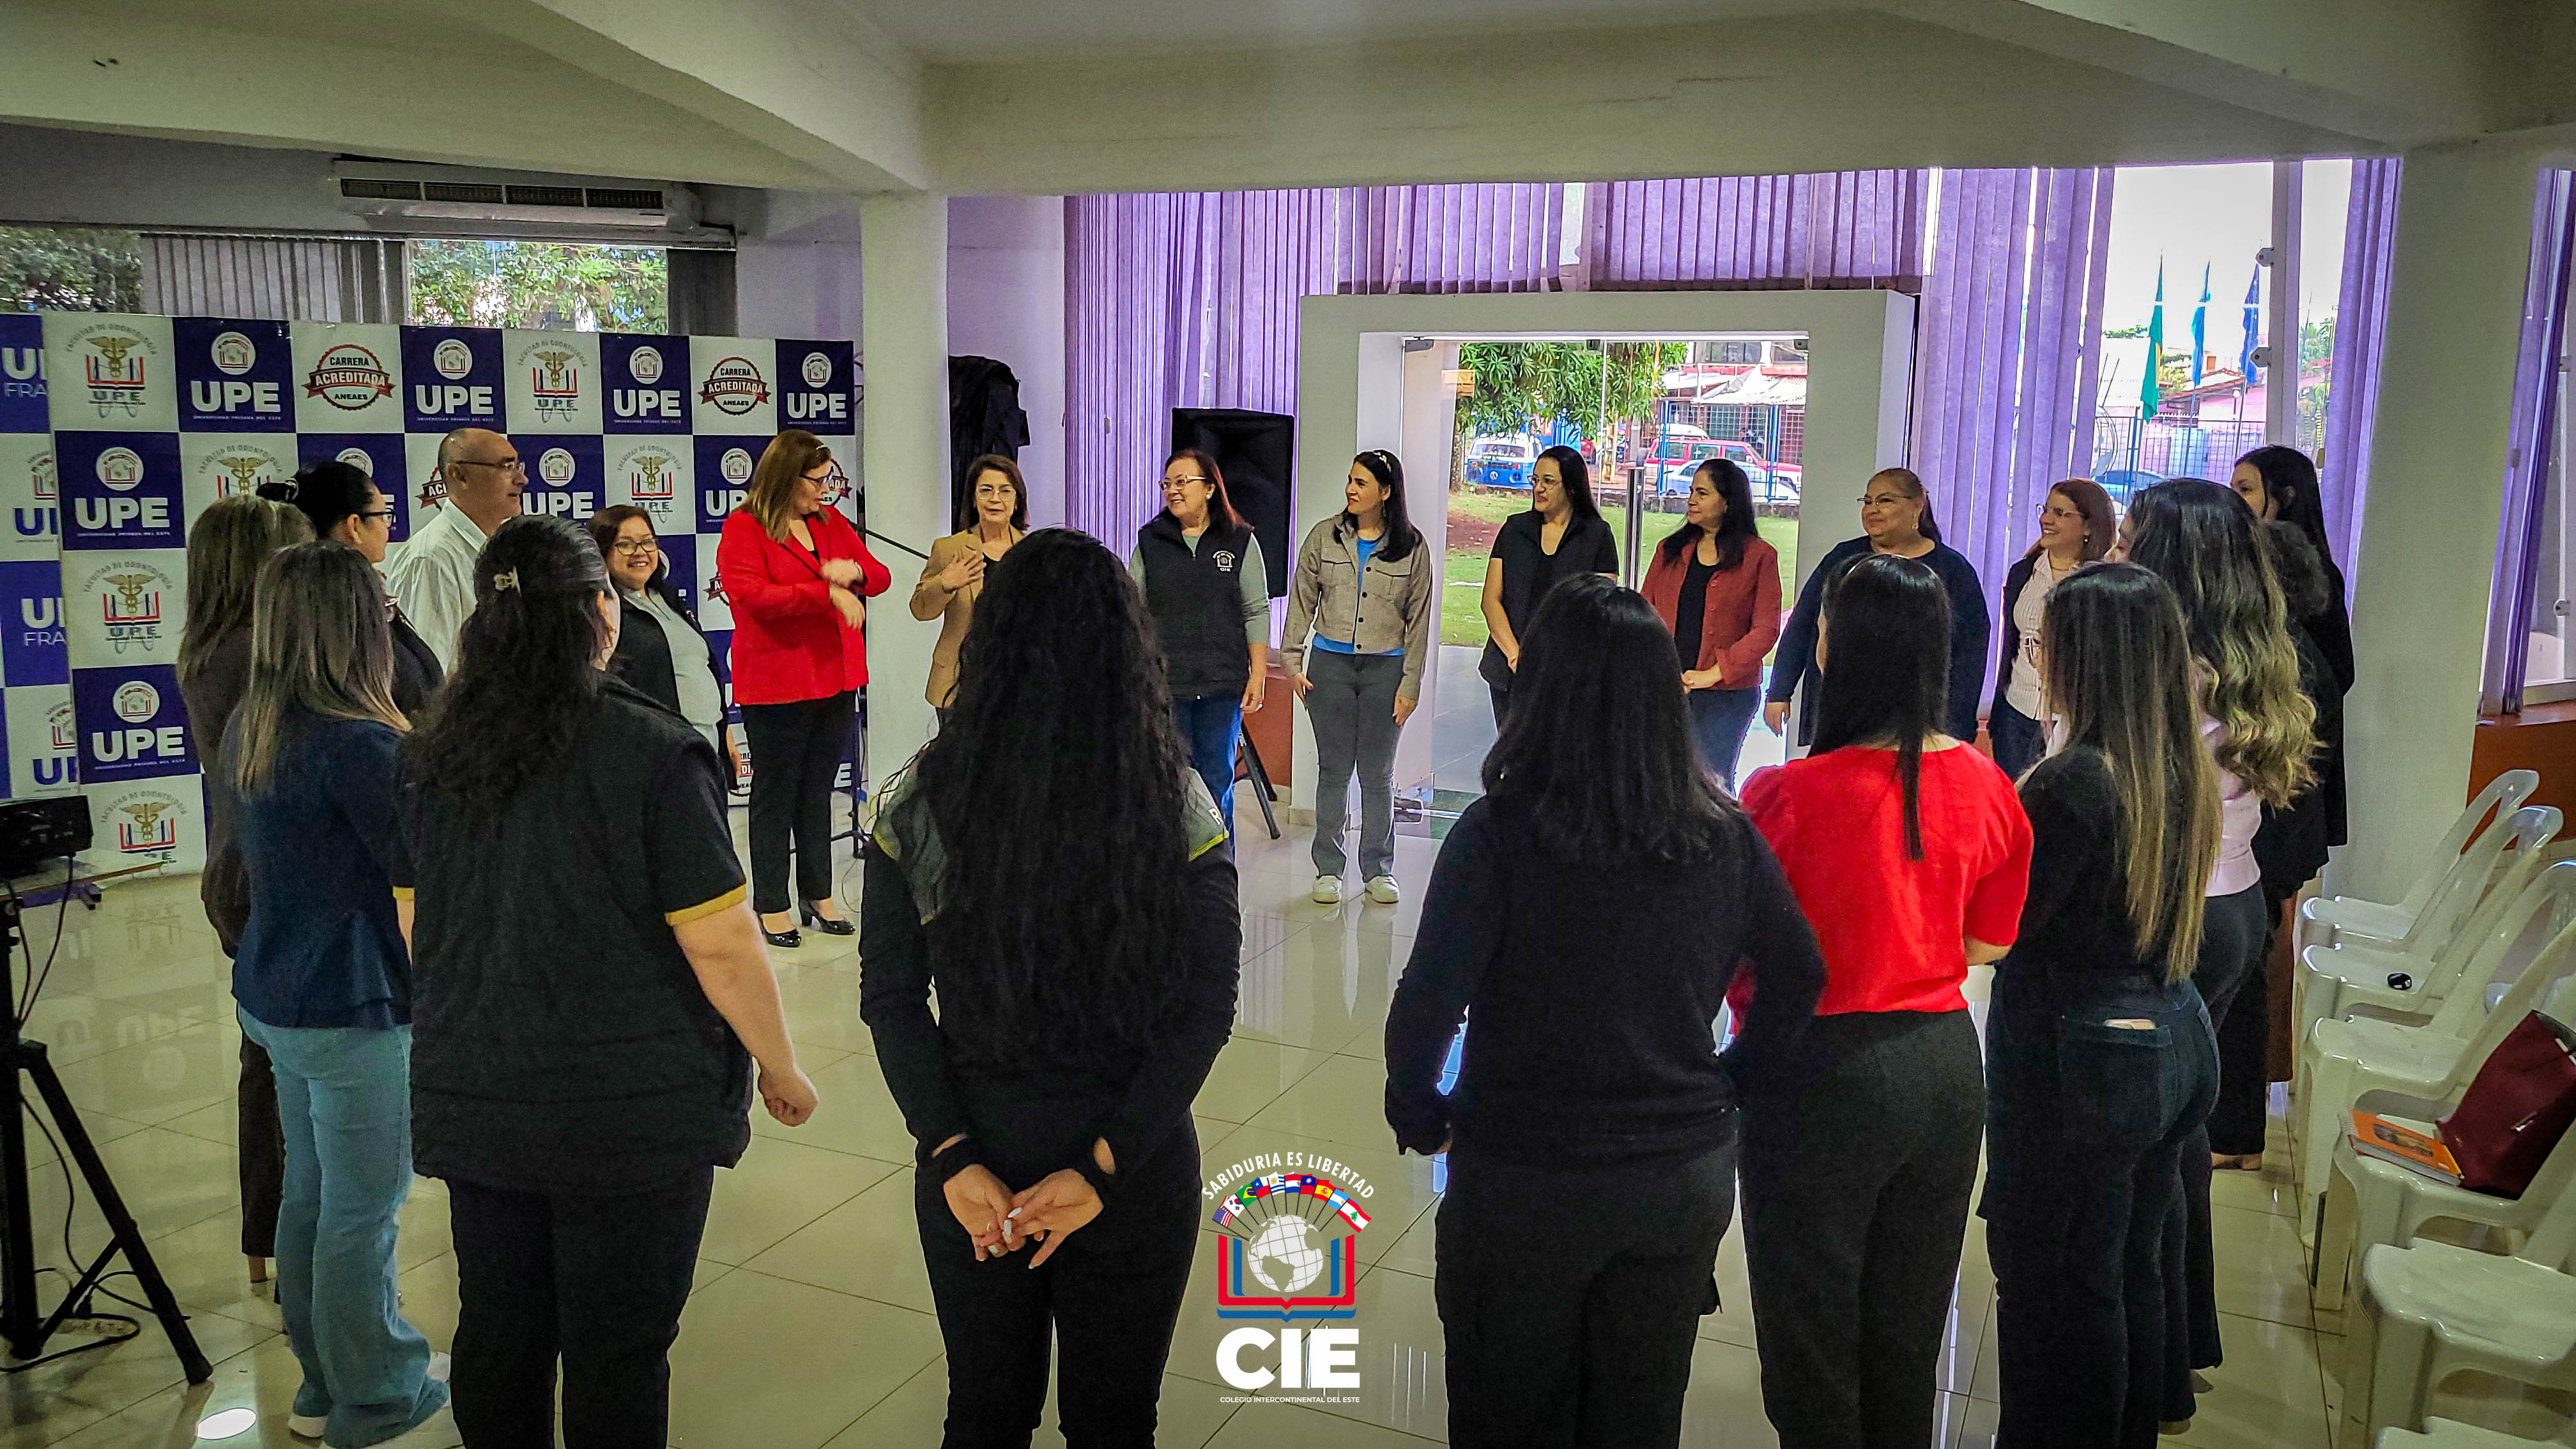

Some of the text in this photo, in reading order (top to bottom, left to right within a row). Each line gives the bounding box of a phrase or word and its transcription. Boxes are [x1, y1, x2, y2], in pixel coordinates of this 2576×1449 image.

[330, 357, 369, 365] CARRERA
[316, 372, 385, 387] ACREDITADA
[709, 381, 763, 394] ACREDITADA
[92, 390, 141, 401] UPE
[190, 381, 281, 412] UPE
[415, 385, 494, 414] UPE
[538, 399, 575, 407] UPE
[613, 389, 681, 417] UPE
[787, 393, 847, 418] UPE
[74, 498, 170, 530] UPE
[523, 491, 595, 519] UPE
[110, 626, 157, 637] UPE
[92, 726, 185, 762] UPE
